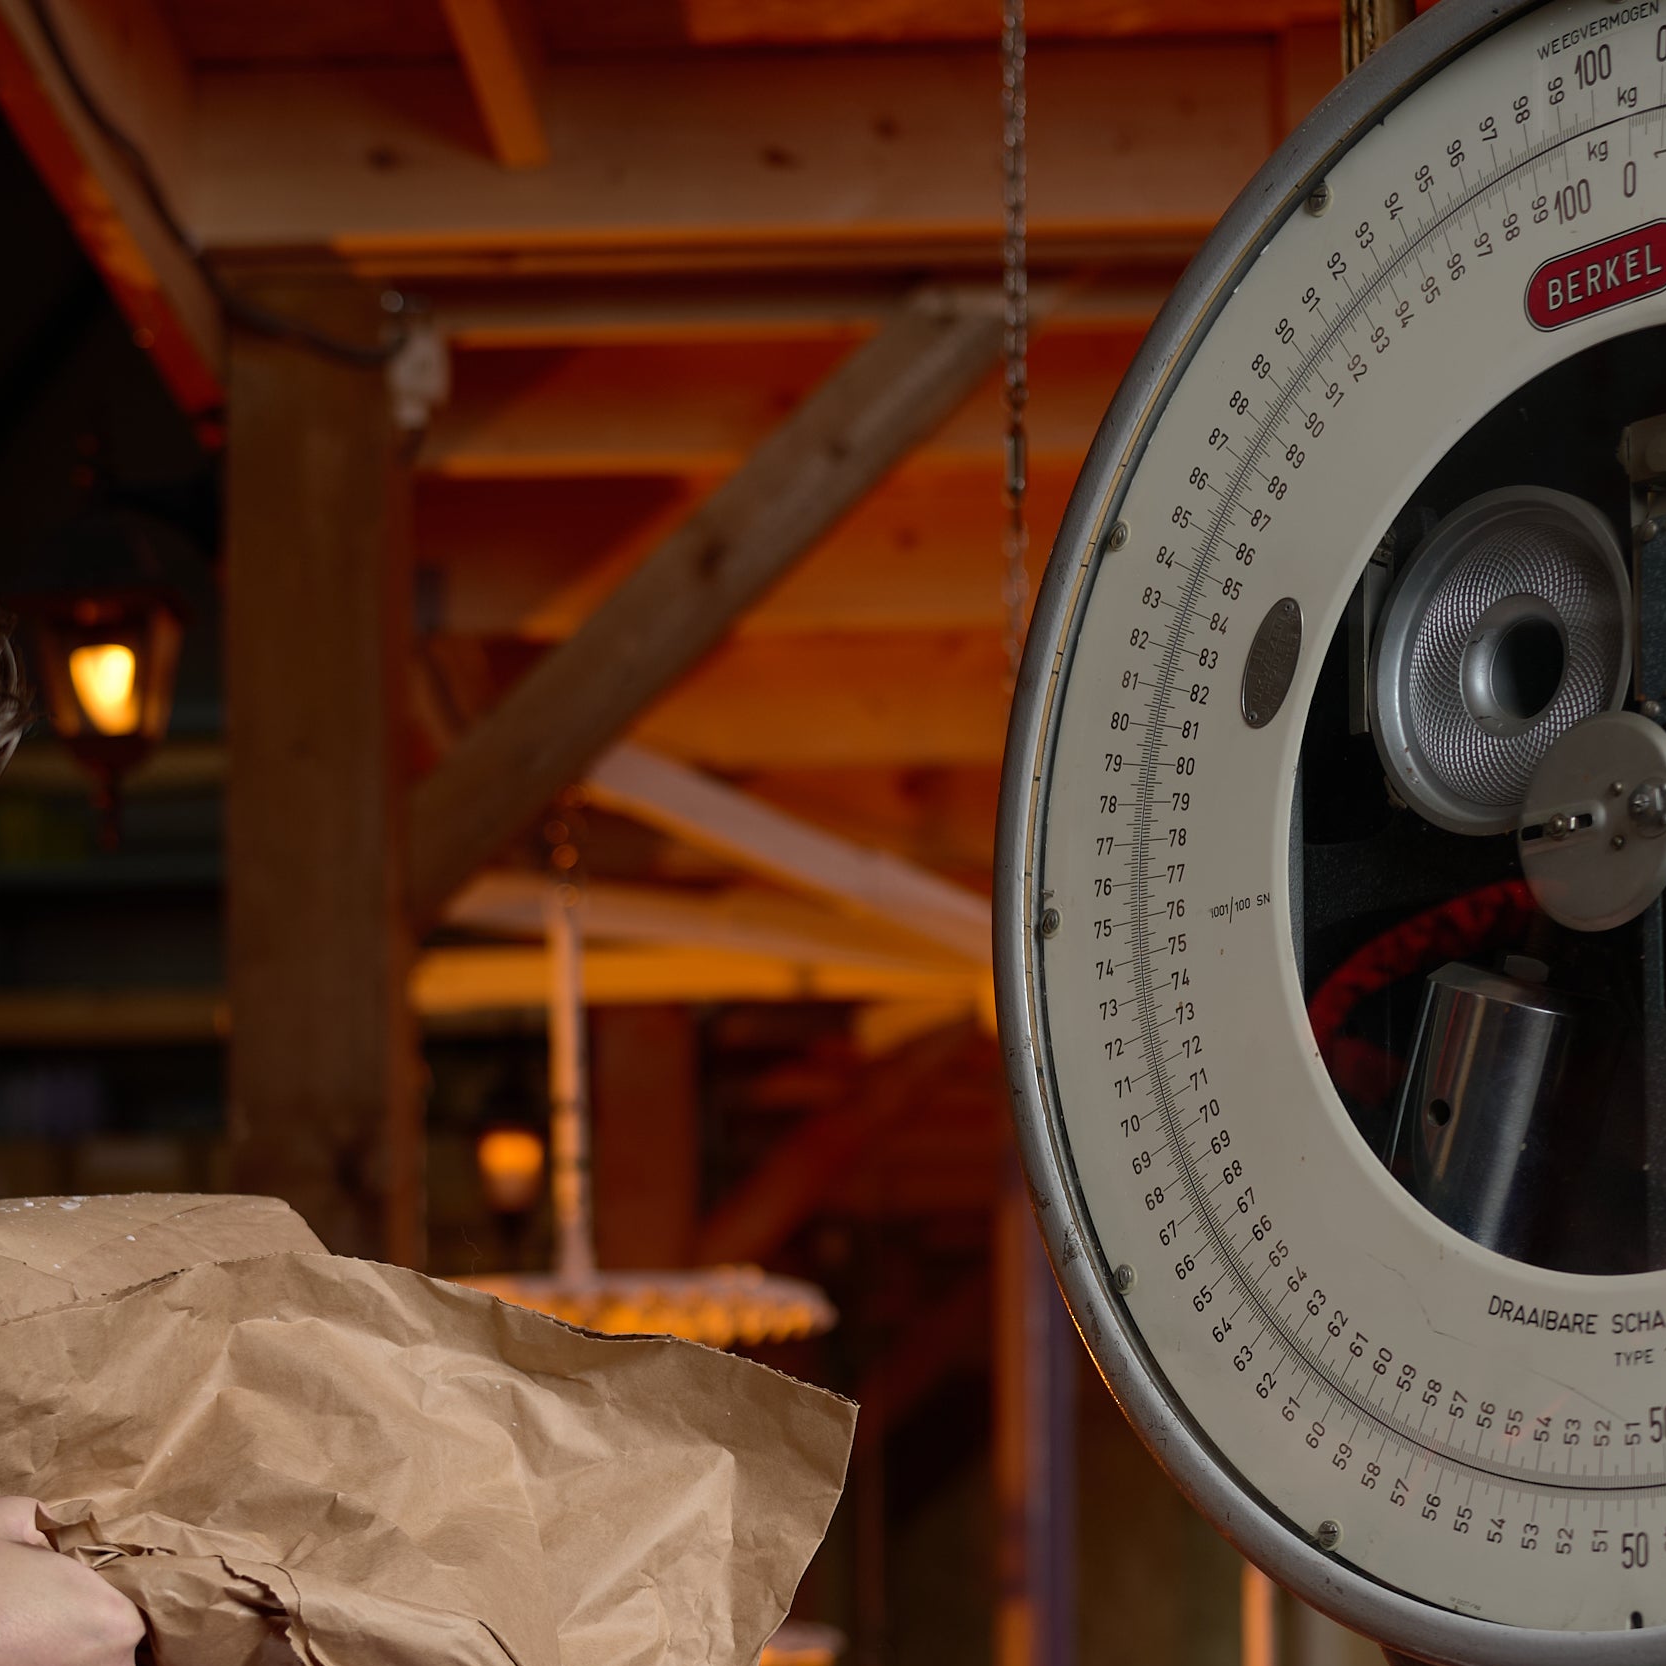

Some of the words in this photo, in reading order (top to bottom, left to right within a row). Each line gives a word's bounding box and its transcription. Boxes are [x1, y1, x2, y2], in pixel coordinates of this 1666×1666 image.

[1537, 3, 1660, 60] WEEGVERMOGEN
[1574, 43, 1613, 90] 100
[1547, 76, 1566, 106] 99
[1617, 86, 1638, 108] kg
[1512, 95, 1531, 125] 98
[1478, 115, 1498, 142] 97
[1446, 138, 1466, 169] 96
[1587, 140, 1609, 162] kg
[1414, 164, 1435, 194] 95
[1383, 191, 1405, 221] 94
[1554, 178, 1592, 226] 100
[1622, 160, 1637, 199] 0
[1531, 195, 1550, 225] 99
[1354, 220, 1375, 250] 93
[1502, 212, 1521, 243] 98
[1476, 231, 1494, 258] 97
[1326, 251, 1348, 282] 92
[1446, 252, 1467, 282] 96
[1547, 243, 1663, 312] BERKEL
[1301, 286, 1322, 314] 91
[1420, 275, 1442, 305] 95
[1394, 300, 1416, 329] 94
[1274, 317, 1295, 345] 90
[1370, 325, 1391, 355] 93
[1251, 353, 1272, 380] 89
[1346, 353, 1369, 383] 92
[1228, 389, 1250, 416] 88
[1324, 382, 1346, 408] 91
[1304, 411, 1326, 439] 90
[1207, 427, 1230, 452] 87
[1284, 443, 1306, 470] 89
[1188, 466, 1210, 491] 86
[1266, 475, 1288, 502] 88
[1170, 505, 1193, 530] 85
[1249, 508, 1272, 532] 87
[1155, 545, 1176, 570] 84
[1234, 541, 1257, 567] 86
[1141, 586, 1162, 610] 83
[1221, 576, 1244, 601] 85
[1209, 611, 1230, 636] 84
[1129, 627, 1150, 651] 82
[1198, 647, 1219, 670] 83
[1121, 669, 1140, 691] 81
[1189, 683, 1210, 705] 82
[1110, 710, 1130, 732] 80
[1181, 719, 1200, 740] 81
[1104, 752, 1123, 773] 79
[1175, 755, 1196, 775] 80
[1099, 794, 1118, 814] 78
[1171, 792, 1191, 809] 79
[1095, 836, 1115, 857] 77
[1168, 827, 1188, 845] 78
[1166, 863, 1186, 881] 77
[1093, 877, 1113, 898] 76
[1256, 892, 1271, 906] SN
[1166, 898, 1186, 917] 76
[1093, 917, 1112, 940] 75
[1167, 932, 1187, 952] 75
[1095, 958, 1114, 981] 74
[1170, 967, 1191, 988] 74
[1098, 997, 1119, 1021] 73
[1174, 1001, 1196, 1023] 73
[1104, 1037, 1125, 1061] 72
[1181, 1034, 1203, 1058] 72
[1113, 1075, 1133, 1099] 71
[1188, 1066, 1209, 1092] 71
[1200, 1099, 1221, 1124] 70
[1119, 1113, 1141, 1138] 70
[1210, 1129, 1231, 1155] 69
[1131, 1150, 1152, 1176] 69
[1222, 1159, 1243, 1186] 68
[1144, 1186, 1165, 1212] 68
[1236, 1187, 1256, 1215] 67
[1158, 1219, 1178, 1247] 67
[1251, 1214, 1273, 1242] 66
[1174, 1253, 1196, 1281] 66
[1267, 1239, 1290, 1268] 65
[1286, 1266, 1308, 1293] 64
[1192, 1284, 1213, 1313] 65
[1306, 1288, 1327, 1317] 63
[1326, 1309, 1349, 1338] 62
[1487, 1295, 1598, 1335] DRAAIBARE
[1211, 1316, 1233, 1344] 64
[1232, 1344, 1254, 1373] 63
[1349, 1332, 1369, 1358] 61
[1613, 1347, 1654, 1368] TYPE
[1372, 1346, 1393, 1376] 60
[1255, 1371, 1278, 1400] 62
[1396, 1363, 1417, 1393] 59
[1422, 1378, 1443, 1408] 58
[1449, 1390, 1469, 1420] 57
[1281, 1395, 1302, 1423] 61
[1476, 1400, 1496, 1430] 56
[1505, 1408, 1524, 1437] 55
[1304, 1420, 1326, 1450] 60
[1534, 1416, 1553, 1443] 54
[1564, 1418, 1582, 1446] 53
[1331, 1442, 1353, 1471] 59
[1360, 1461, 1382, 1491] 58
[1389, 1477, 1410, 1508] 57
[1421, 1492, 1442, 1522] 56
[1452, 1505, 1473, 1535] 55
[1485, 1517, 1506, 1544] 54
[1520, 1522, 1539, 1551] 53
[1621, 1531, 1650, 1569] 50
